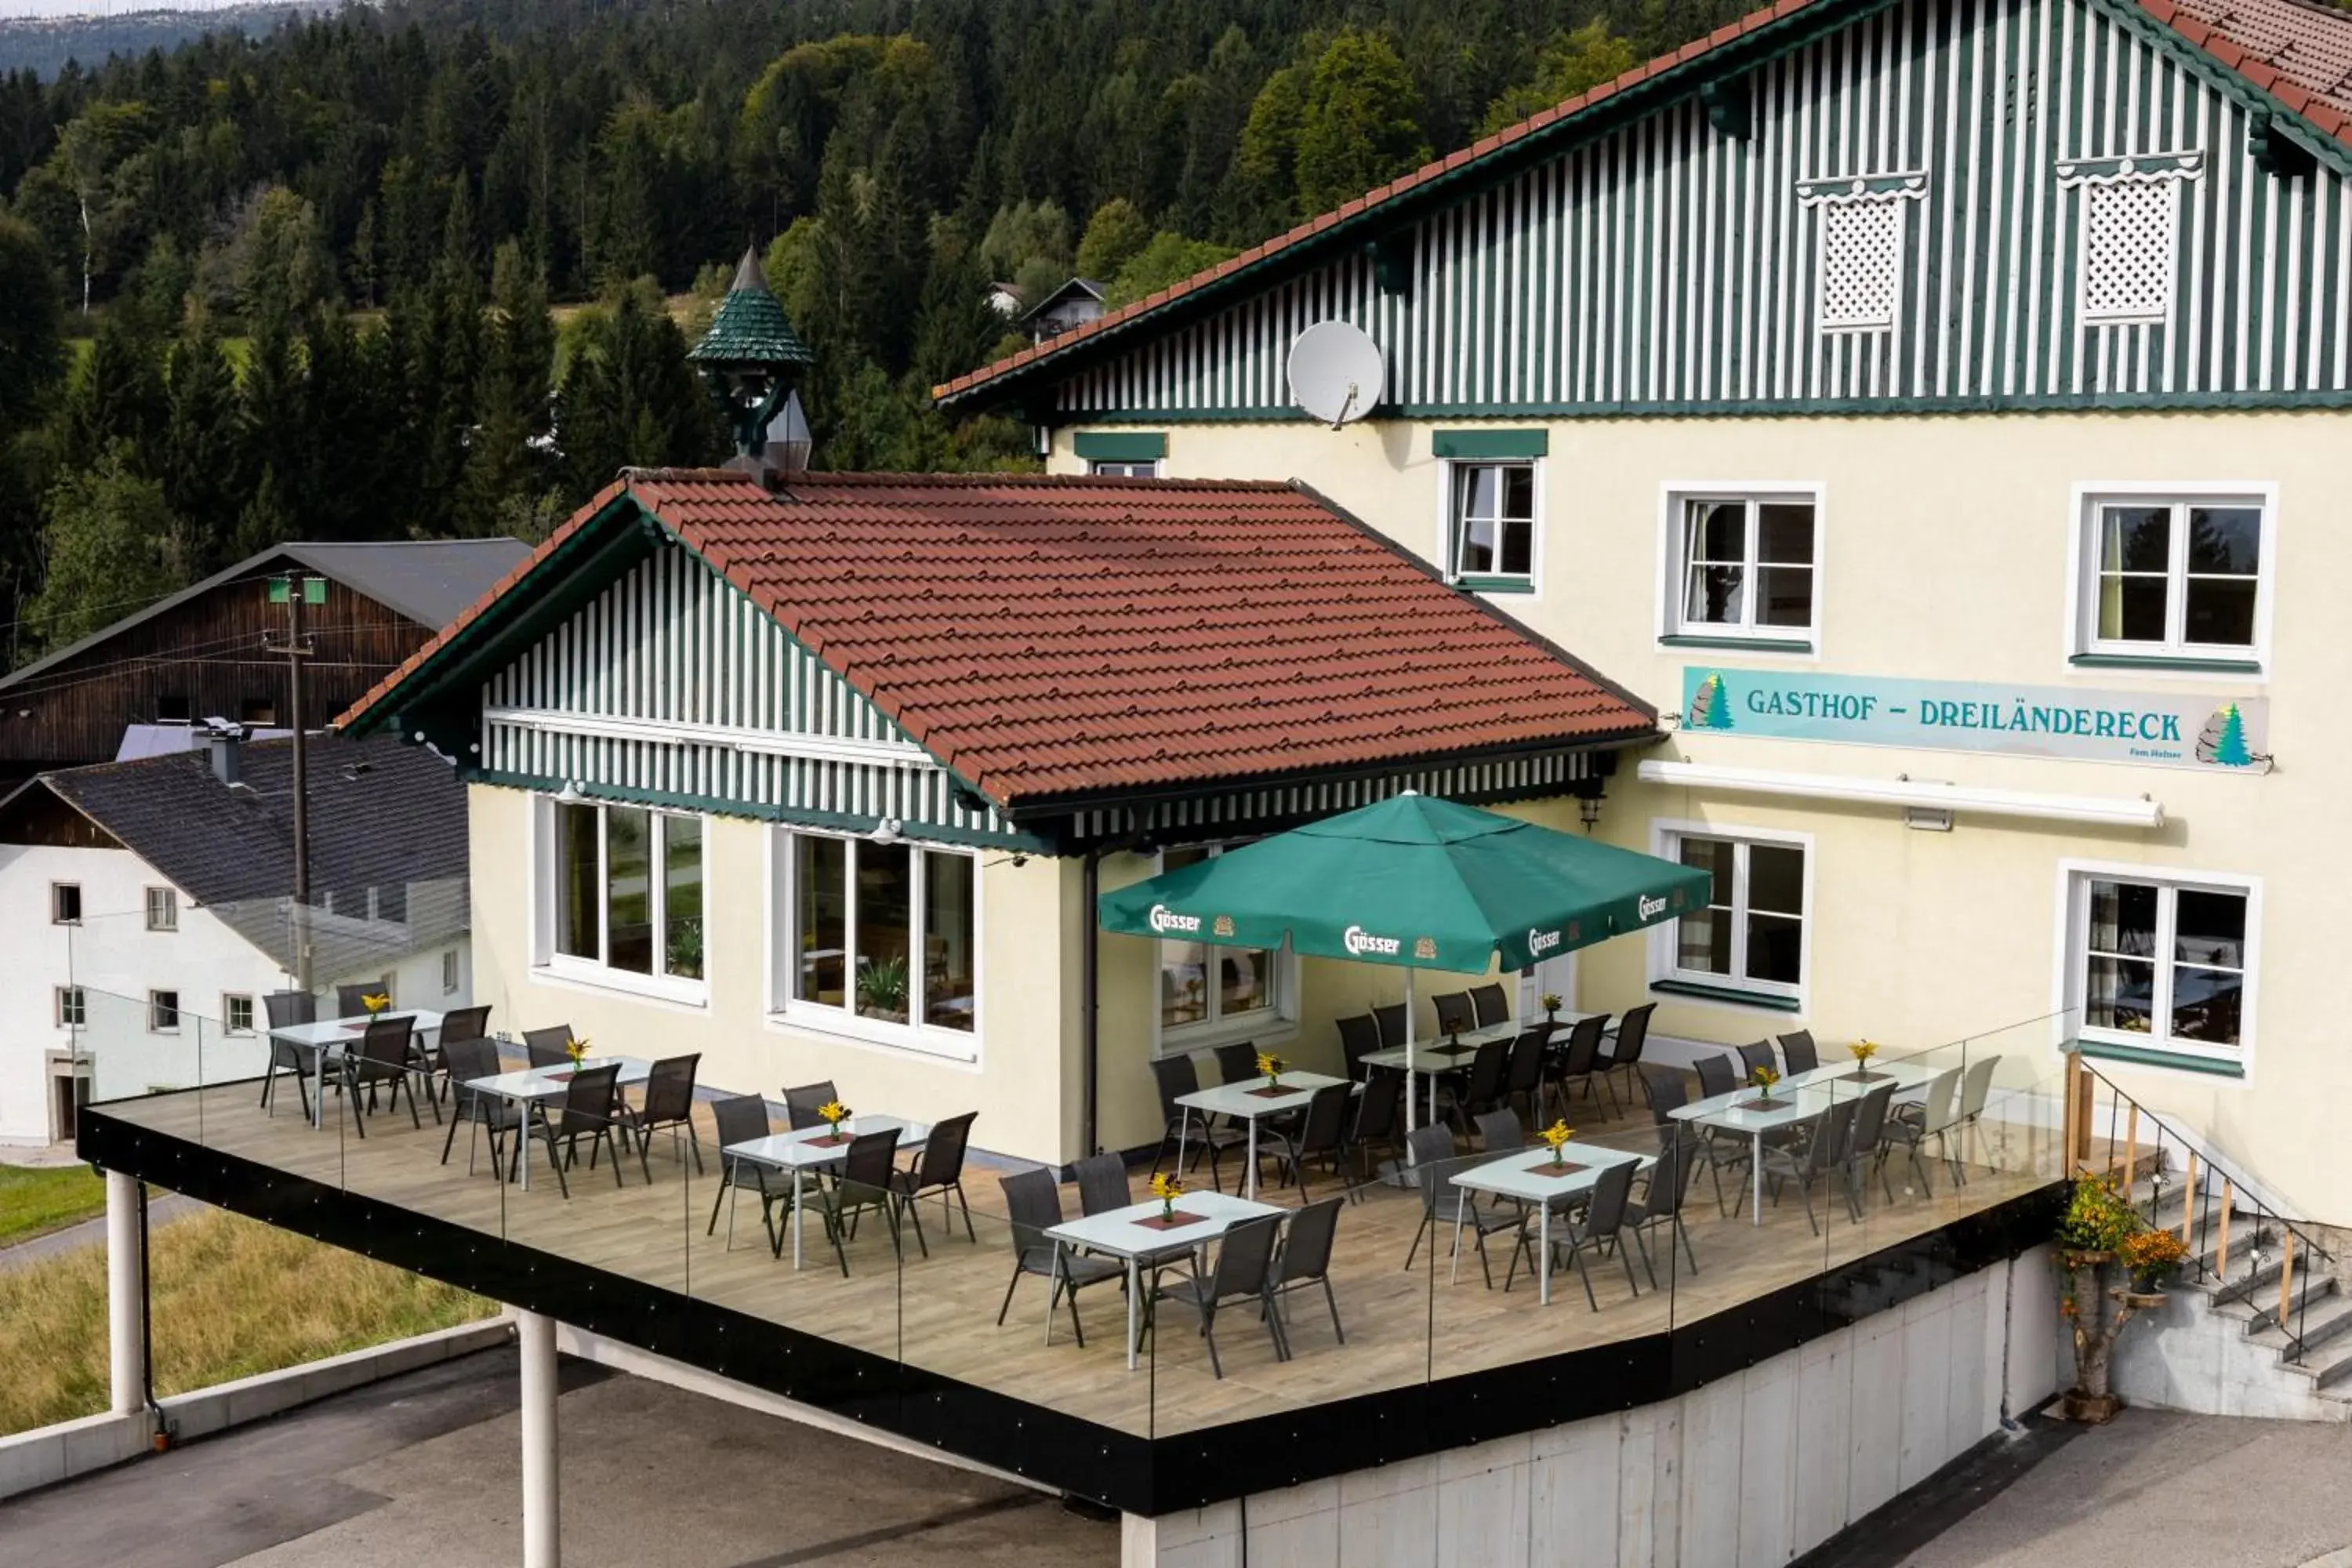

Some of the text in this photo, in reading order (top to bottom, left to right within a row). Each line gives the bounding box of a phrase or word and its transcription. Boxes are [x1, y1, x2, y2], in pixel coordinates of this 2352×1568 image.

[1747, 689, 1878, 722] GASTHOF
[1920, 697, 2181, 742] DREILÄNDERECK
[1149, 904, 1201, 933] Gösser
[1639, 894, 1667, 922] Gösser
[1344, 925, 1401, 956] Gösser
[1529, 927, 1562, 956] Gösser
